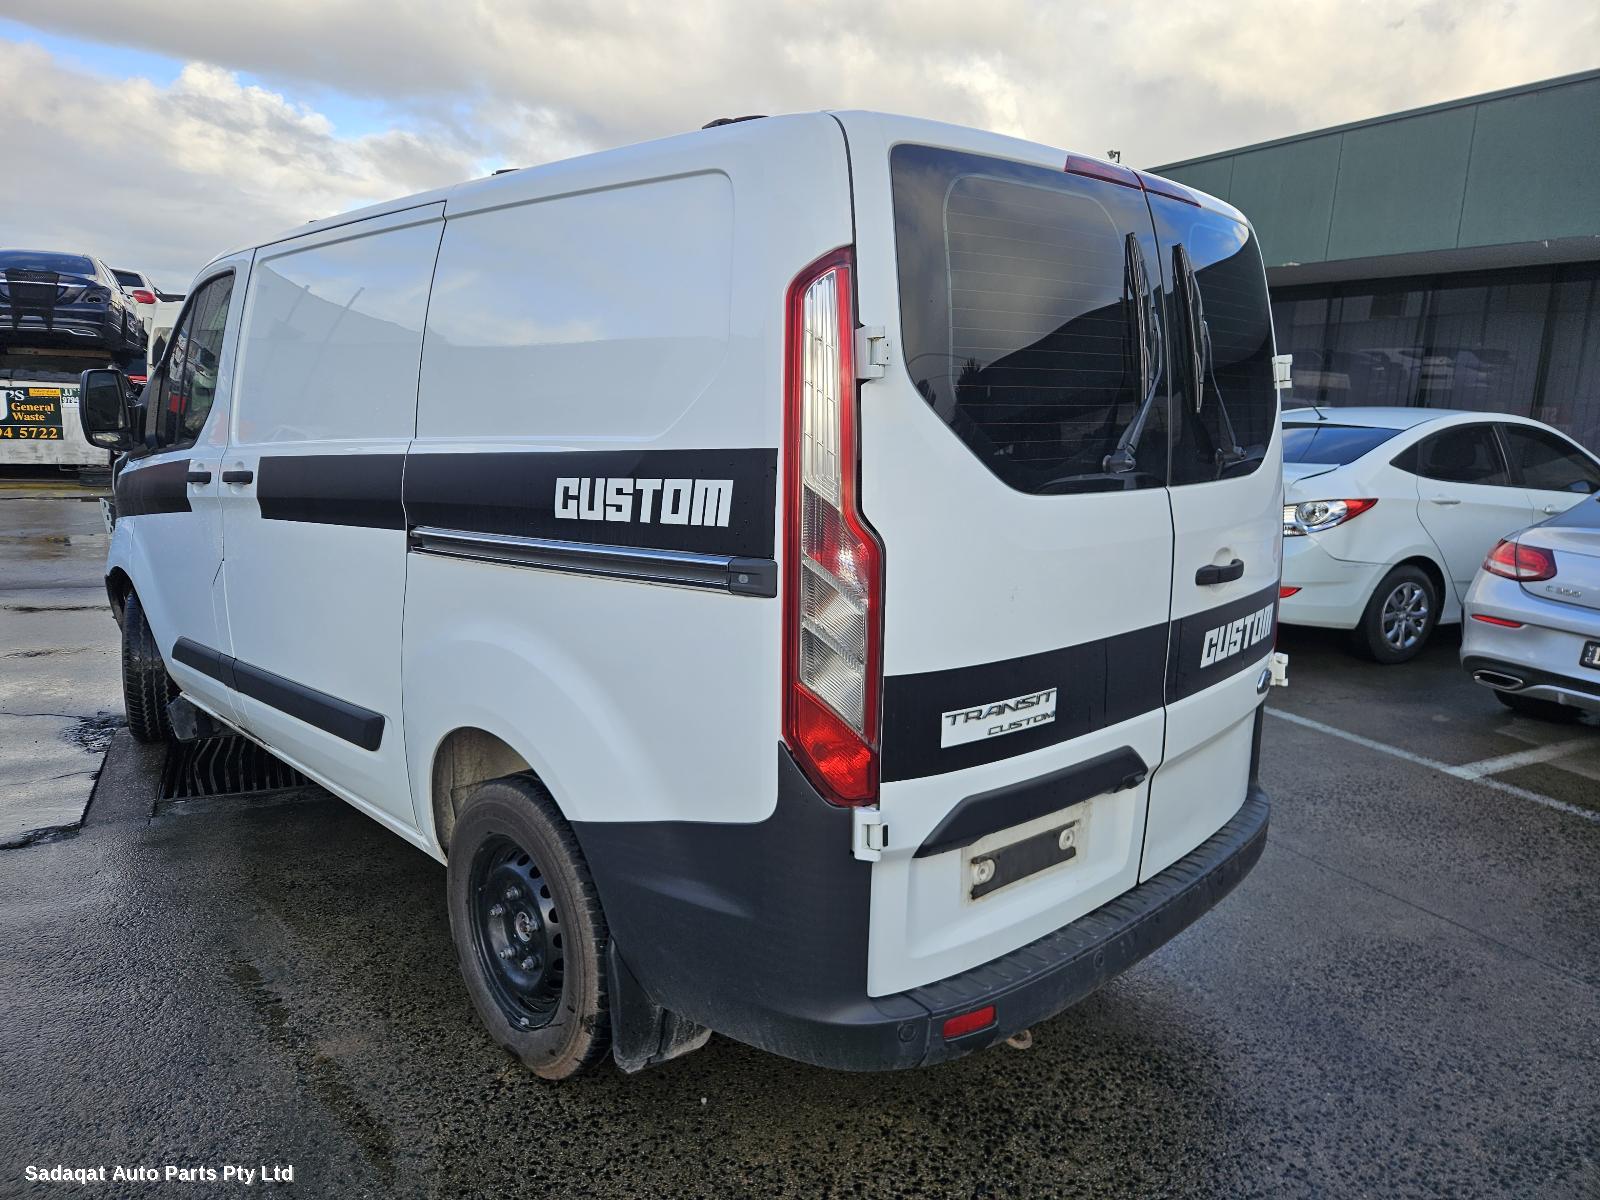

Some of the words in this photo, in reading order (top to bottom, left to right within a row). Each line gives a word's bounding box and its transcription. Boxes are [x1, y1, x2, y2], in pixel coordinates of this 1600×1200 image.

[11, 403, 55, 412] General
[12, 412, 45, 421] Waste
[19, 427, 58, 438] 5722
[554, 477, 734, 528] CUSTOM
[1200, 602, 1274, 669] CUSTOM
[945, 690, 1056, 726] TRANSIT
[987, 710, 1056, 736] CUSTOM
